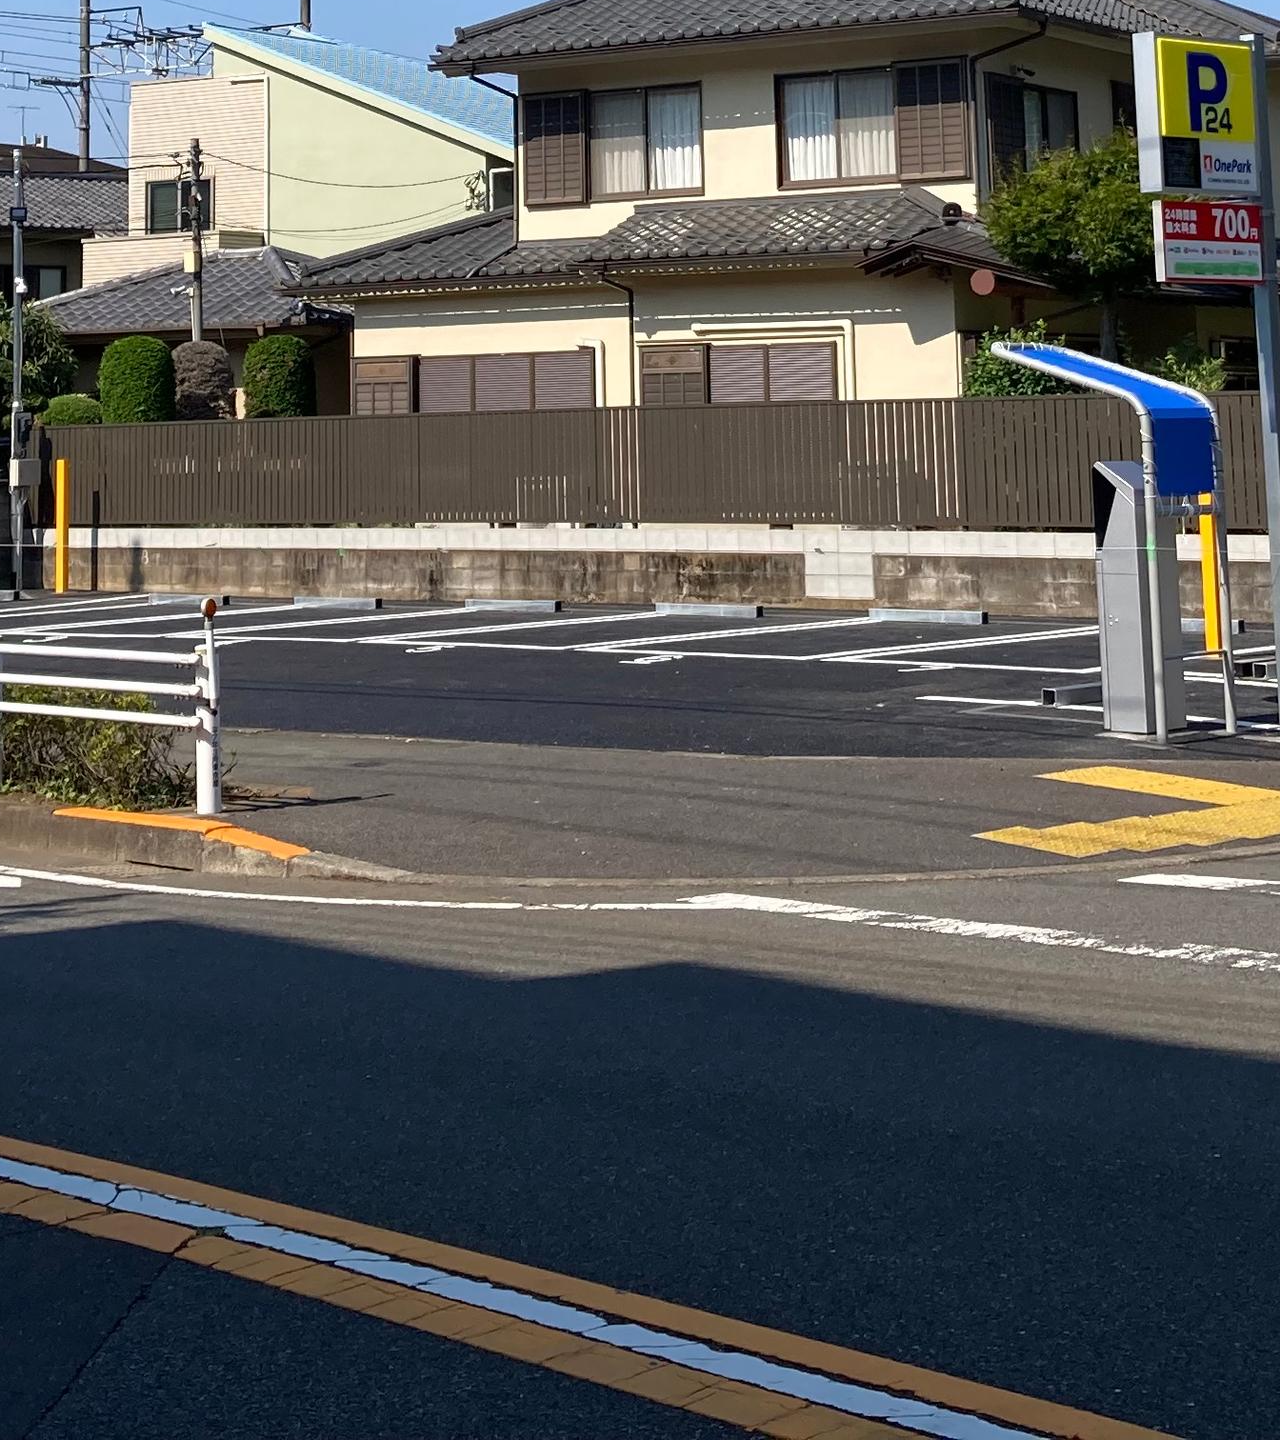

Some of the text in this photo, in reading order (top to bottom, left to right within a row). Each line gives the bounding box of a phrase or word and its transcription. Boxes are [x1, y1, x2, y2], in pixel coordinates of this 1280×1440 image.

[1185, 51, 1228, 133] P
[1205, 106, 1233, 134] 24
[1213, 158, 1253, 175] OnePark
[1211, 208, 1258, 240] 700円
